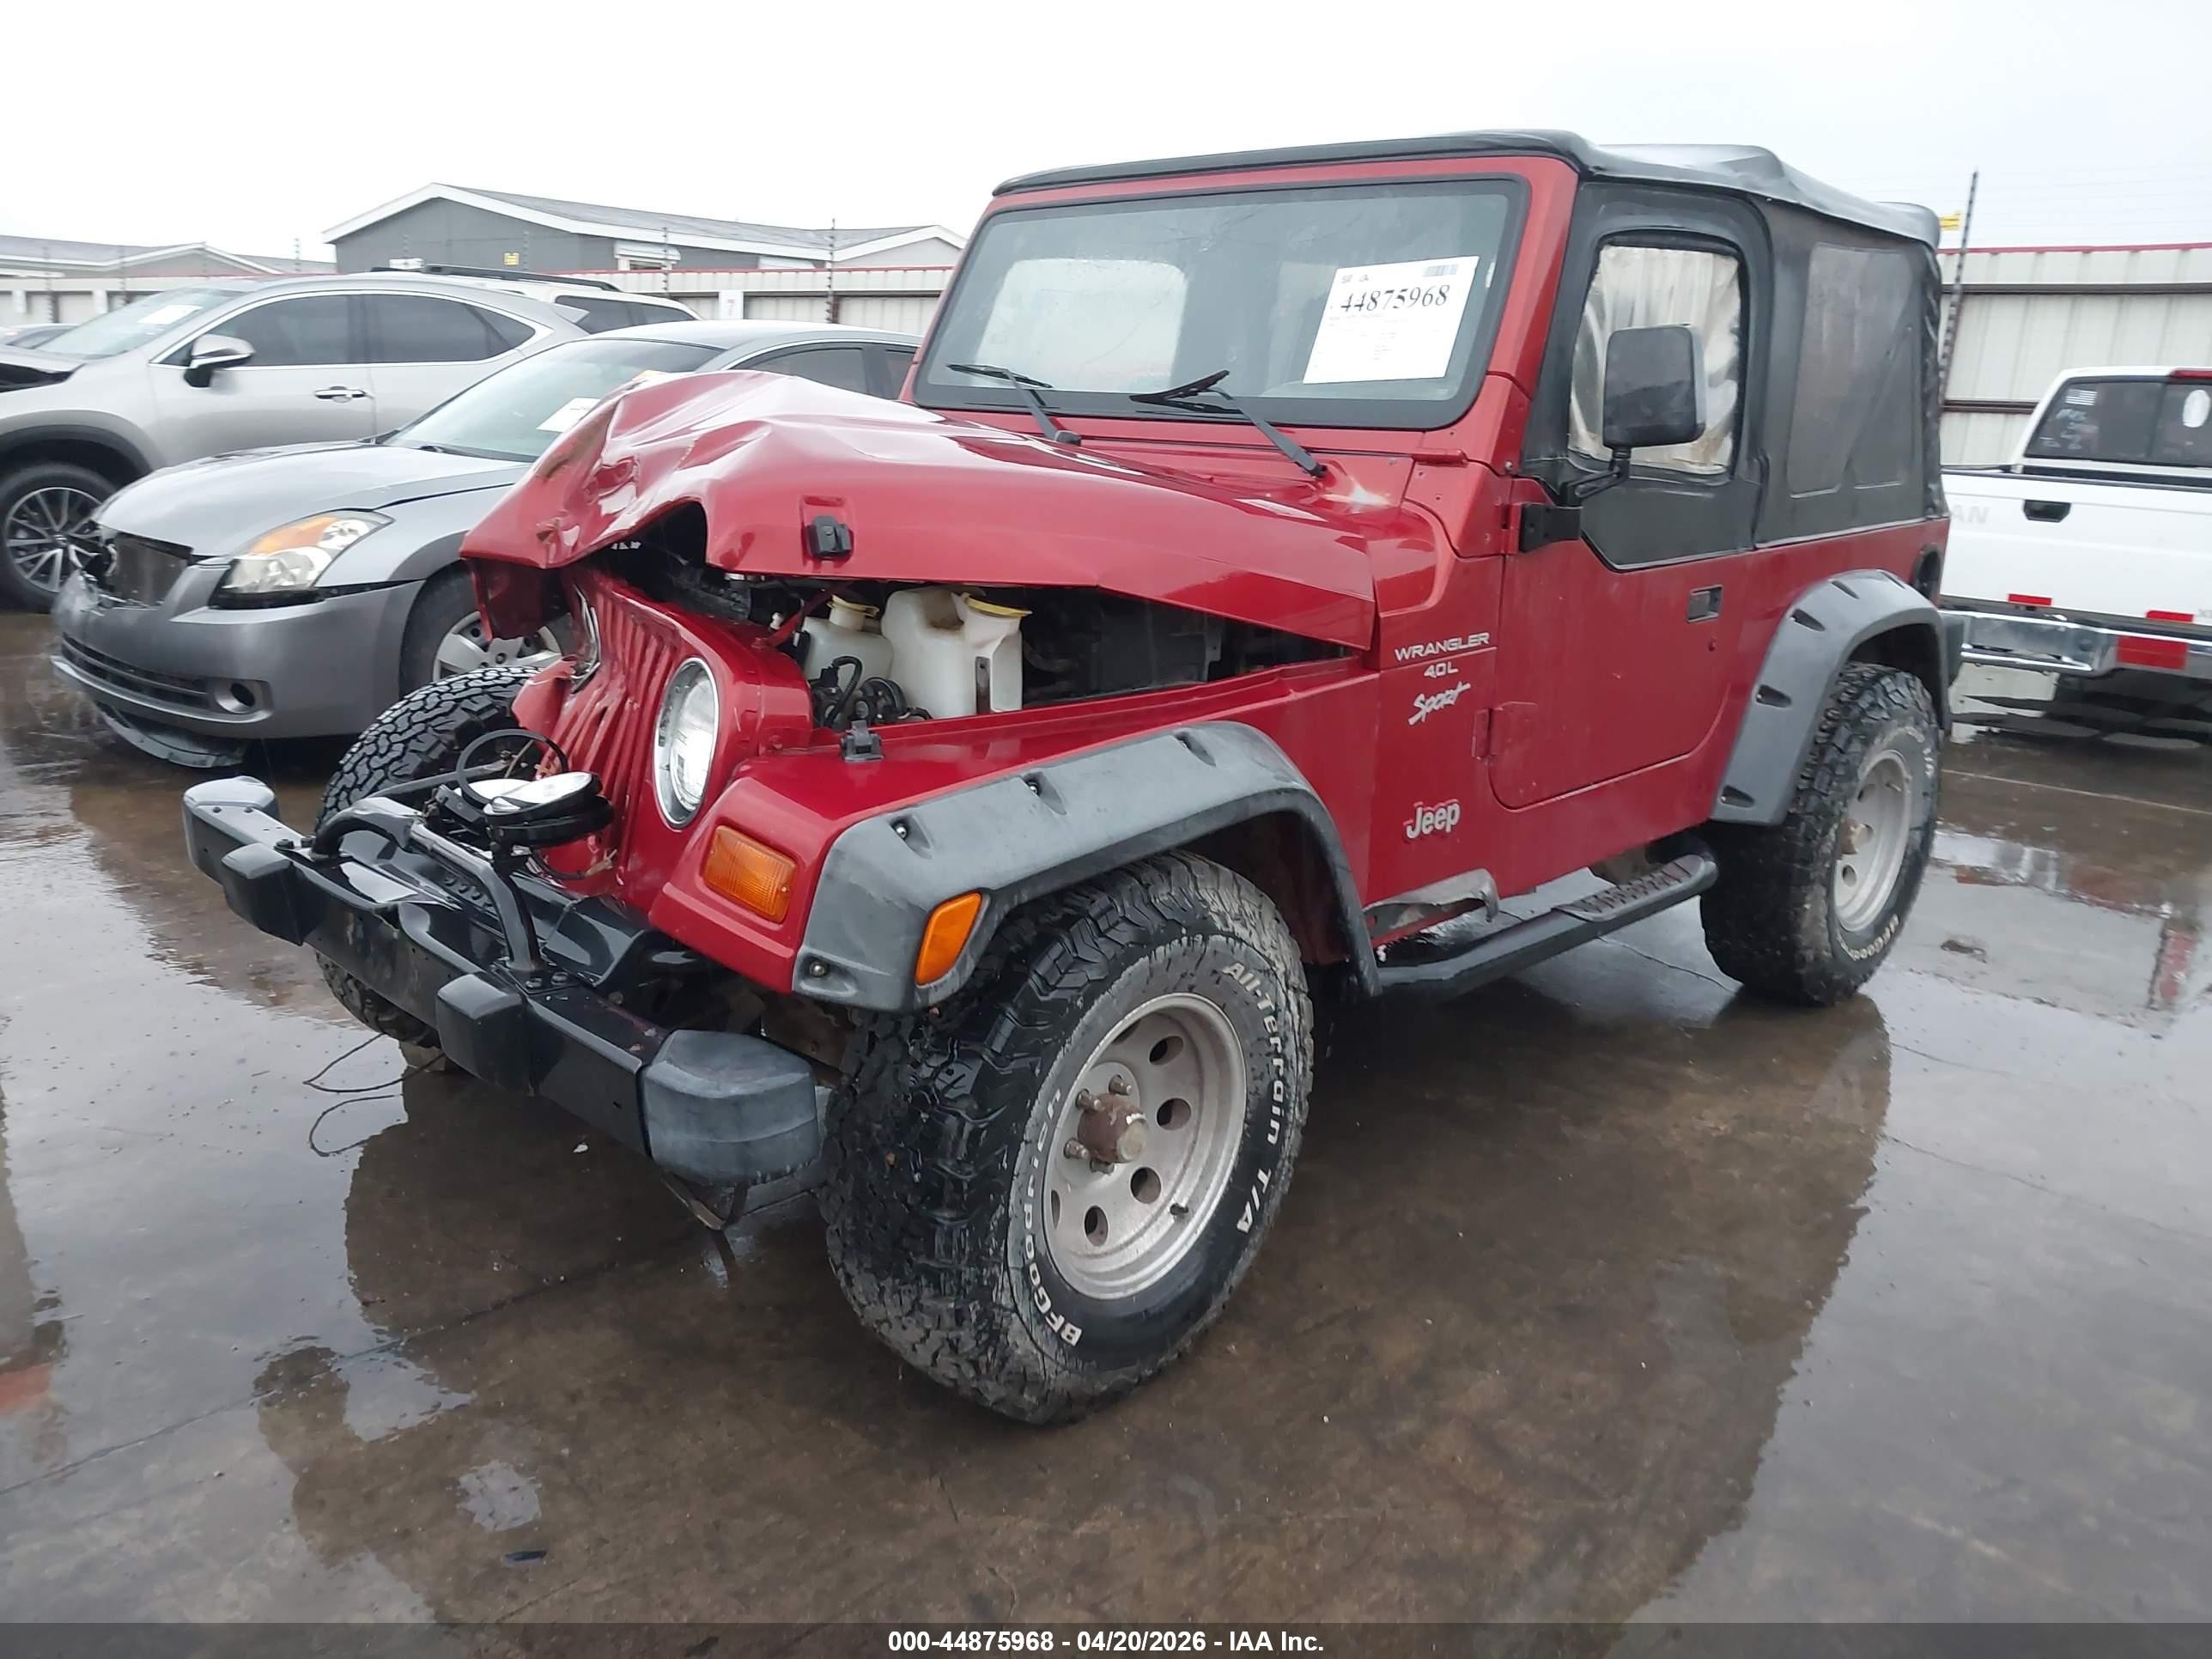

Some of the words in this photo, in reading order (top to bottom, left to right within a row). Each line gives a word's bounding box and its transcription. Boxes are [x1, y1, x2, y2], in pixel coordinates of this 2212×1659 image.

[1340, 284, 1450, 313] 44875968
[1395, 632, 1490, 661] WRANGLER
[1408, 681, 1471, 726] Sport
[1406, 801, 1460, 839] Jeep
[1237, 1168, 1273, 1234] T/A
